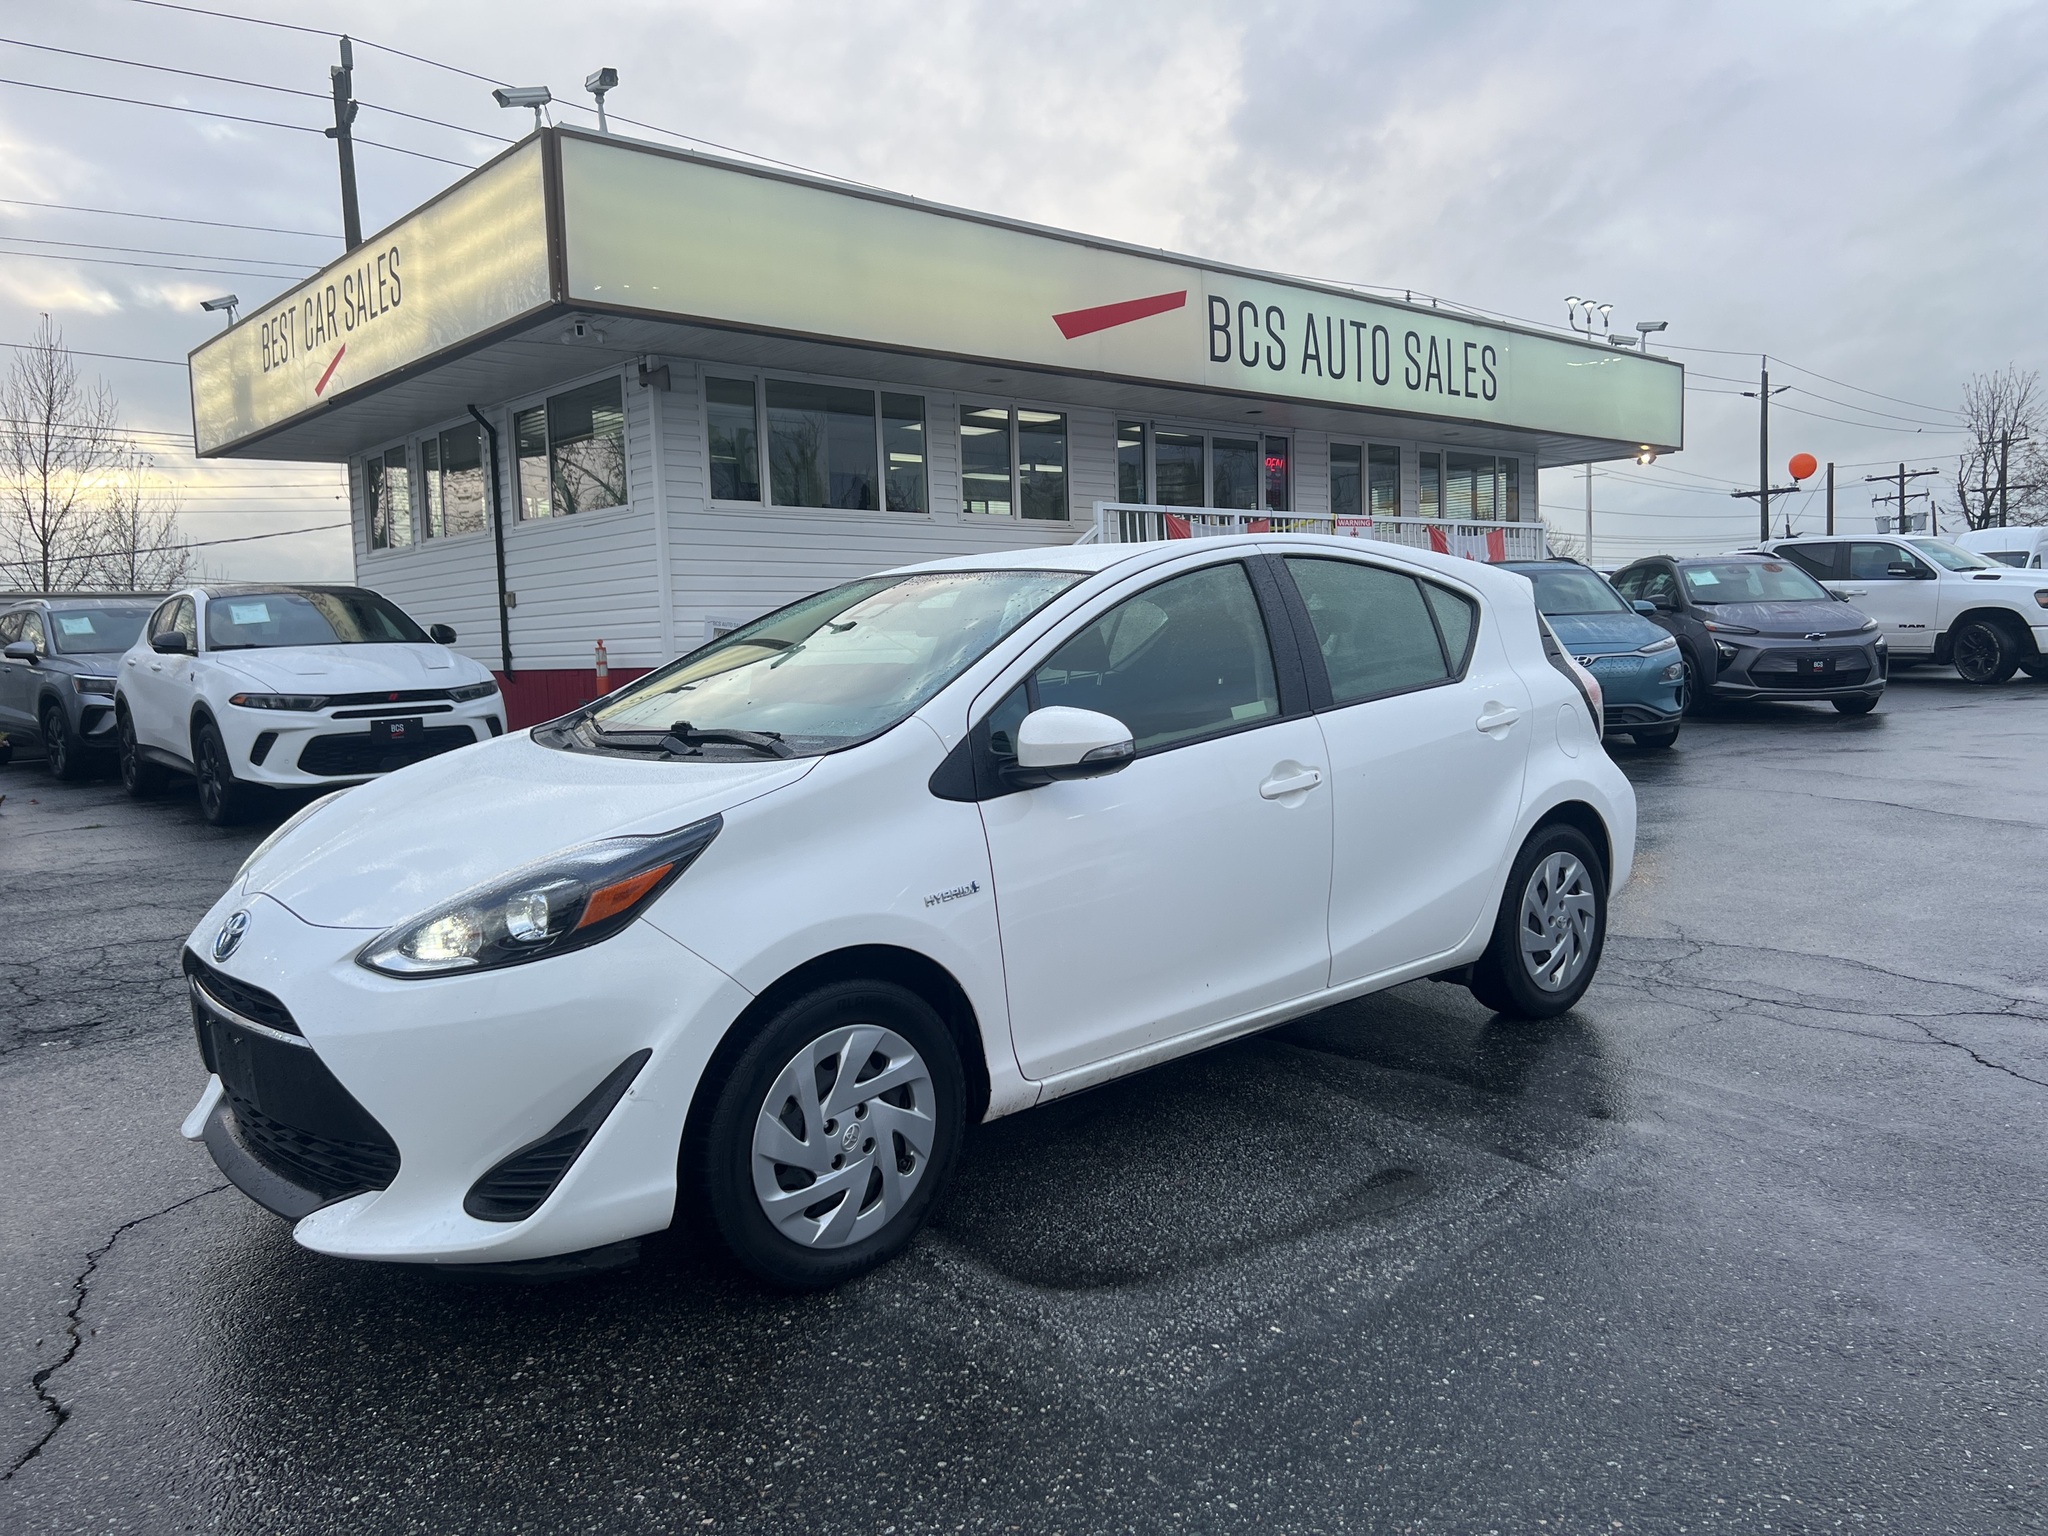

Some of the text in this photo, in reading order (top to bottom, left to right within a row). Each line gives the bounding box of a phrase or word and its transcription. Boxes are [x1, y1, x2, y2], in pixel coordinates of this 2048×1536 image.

[262, 246, 401, 373] BEST CAR SALES
[1207, 295, 1497, 401] BCS AUTO SALES
[1264, 457, 1284, 472] PEN
[1338, 519, 1371, 527] WARNING
[390, 723, 405, 733] BCS
[923, 885, 972, 908] HYBRID
